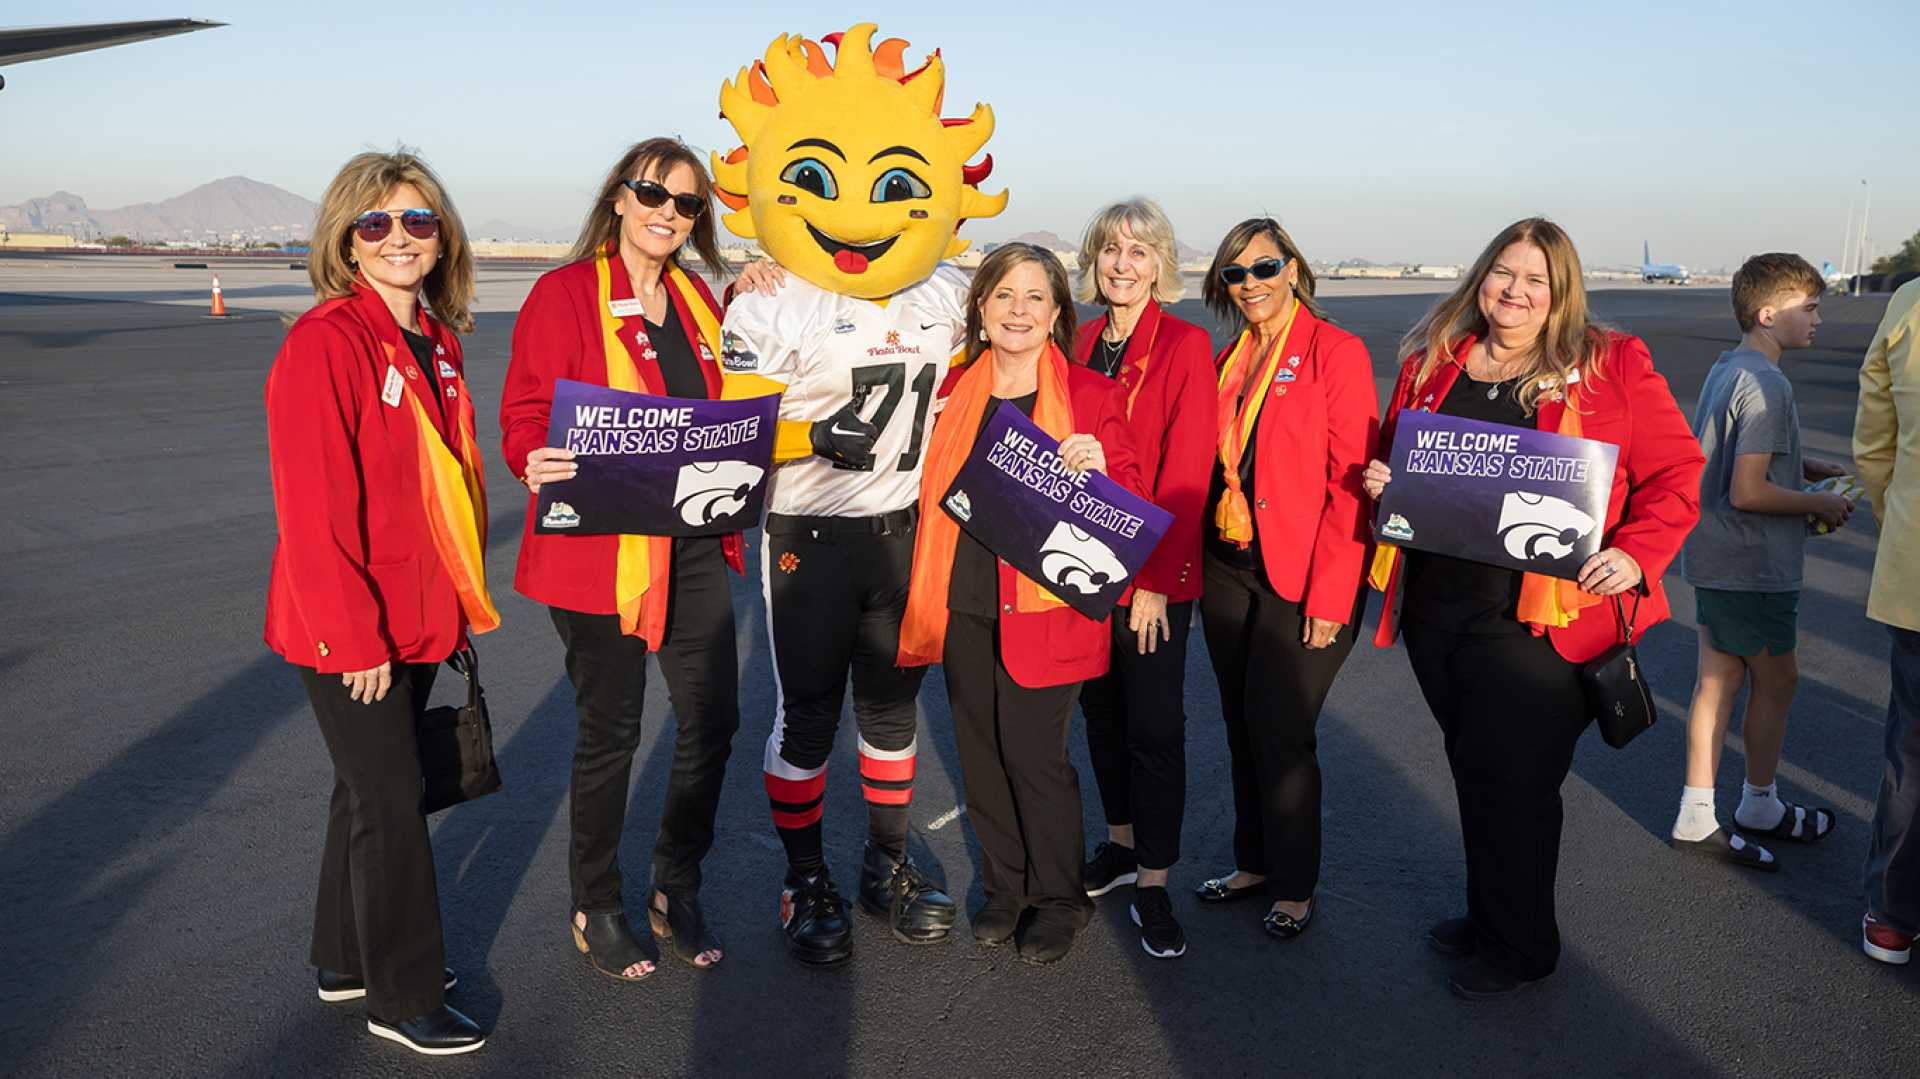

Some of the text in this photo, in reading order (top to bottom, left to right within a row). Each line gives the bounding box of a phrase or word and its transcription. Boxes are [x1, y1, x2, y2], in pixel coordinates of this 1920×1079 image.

[867, 345, 920, 356] Fiesta Bowl
[575, 405, 694, 428] WELCOME
[832, 363, 936, 472] 71
[567, 416, 760, 455] KANSAS STATE
[1417, 430, 1520, 453] WELCOME
[1407, 450, 1591, 482] KANSAS STATE
[987, 441, 1144, 539] KANSAS STATE
